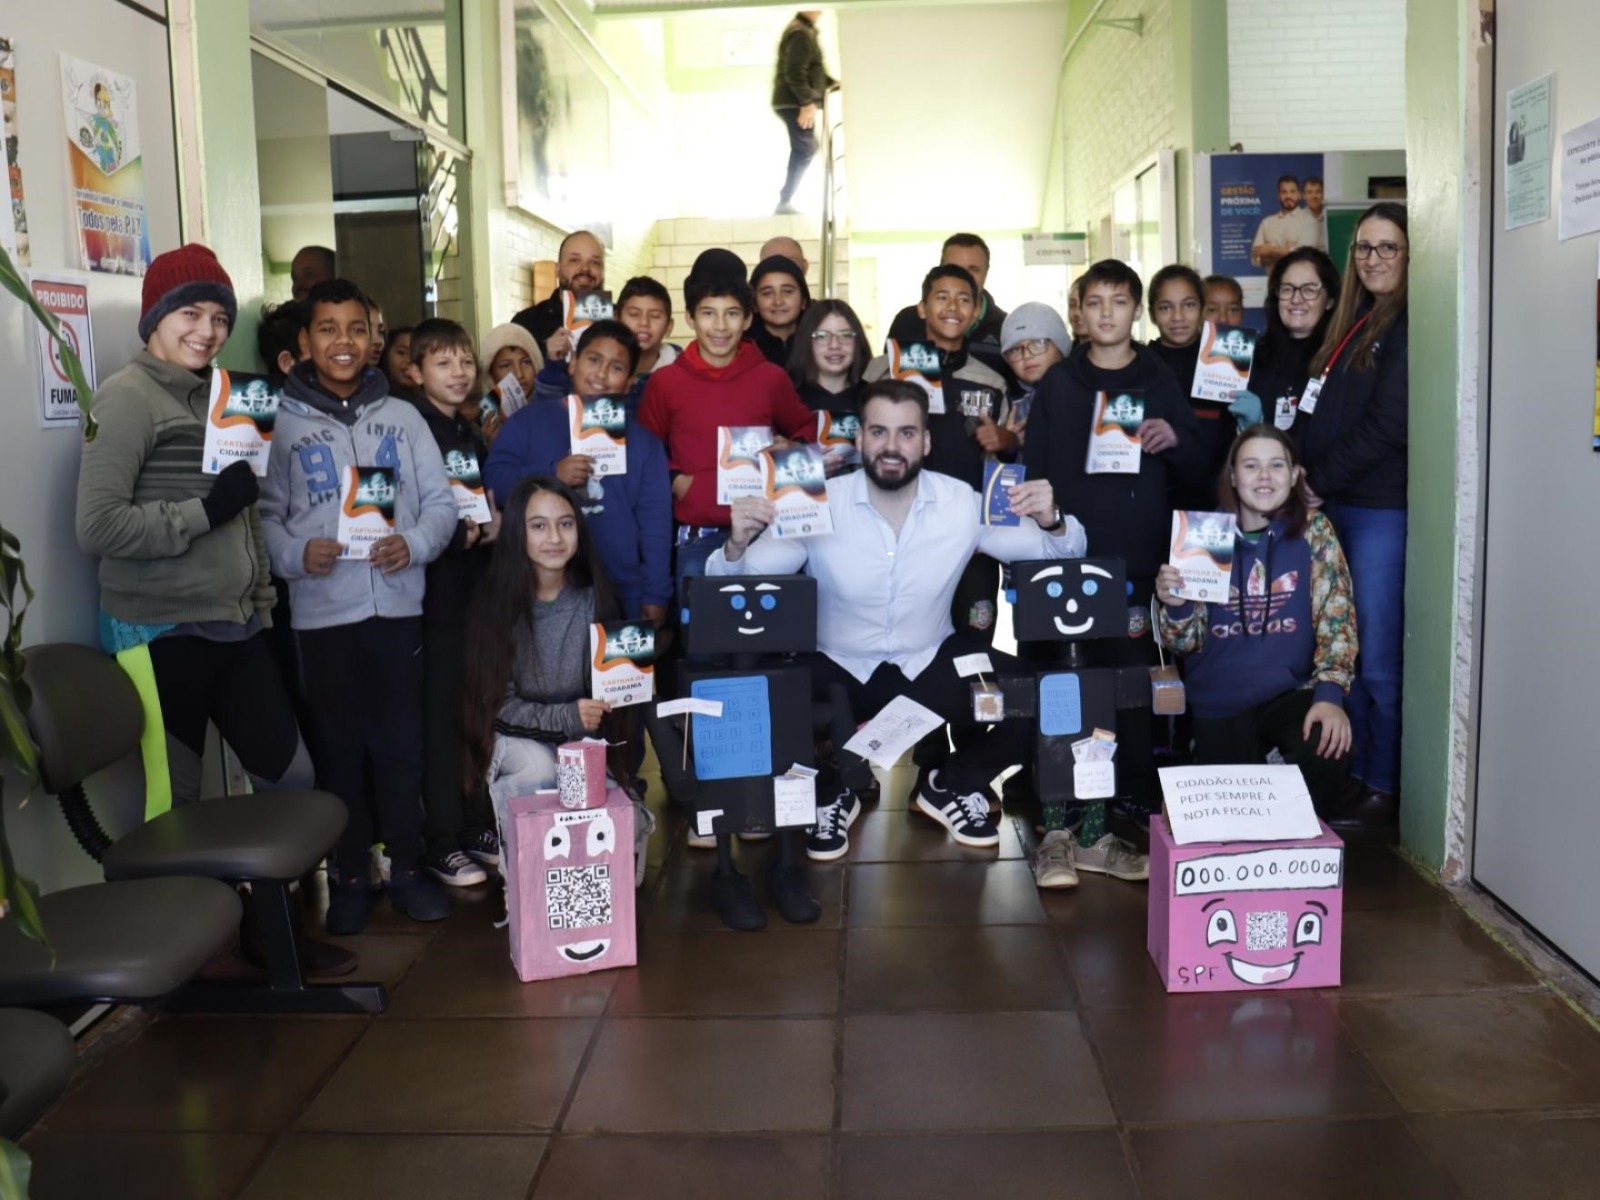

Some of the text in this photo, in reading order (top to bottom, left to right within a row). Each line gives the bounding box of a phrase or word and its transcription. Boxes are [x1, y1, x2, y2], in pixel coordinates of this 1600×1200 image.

[36, 290, 84, 309] PROIBIDO
[50, 388, 78, 404] FUMA
[299, 443, 339, 493] 9
[605, 682, 642, 693] CIDADANIA
[1176, 776, 1275, 789] CIDADÃO LEGAL
[1180, 790, 1276, 805] PEDE SEMPRE A
[1184, 807, 1221, 821] NOTA
[1223, 806, 1264, 816] FISCAL
